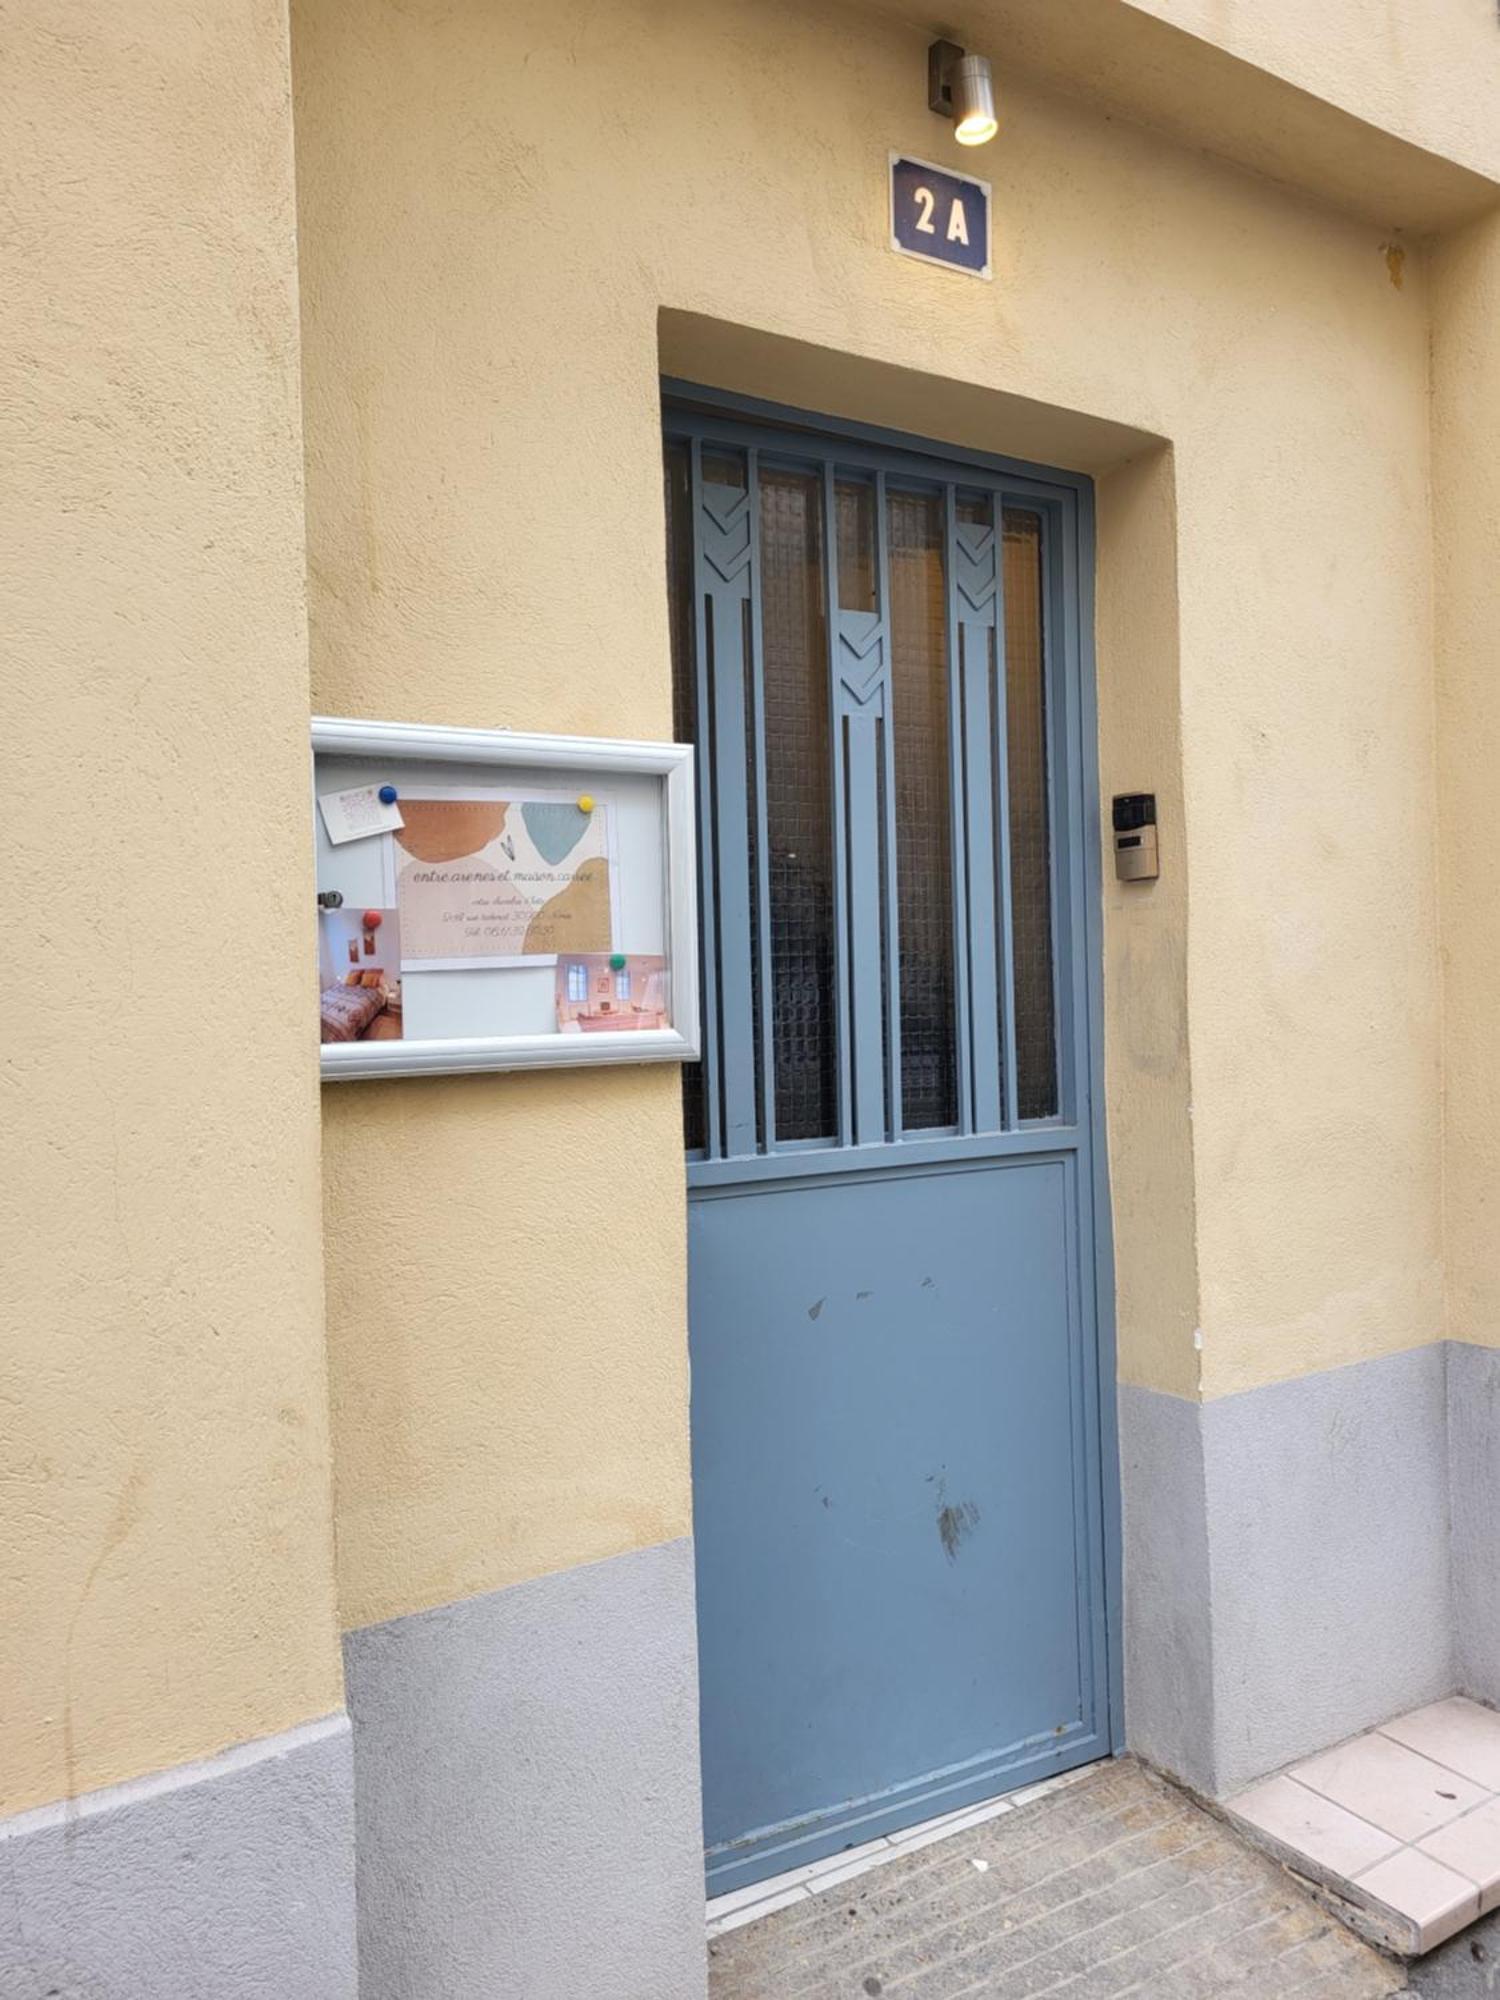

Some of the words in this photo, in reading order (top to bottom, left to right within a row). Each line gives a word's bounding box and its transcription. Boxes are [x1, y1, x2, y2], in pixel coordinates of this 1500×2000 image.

[914, 187, 935, 234] 2
[946, 198, 969, 246] A
[412, 870, 449, 882] entre
